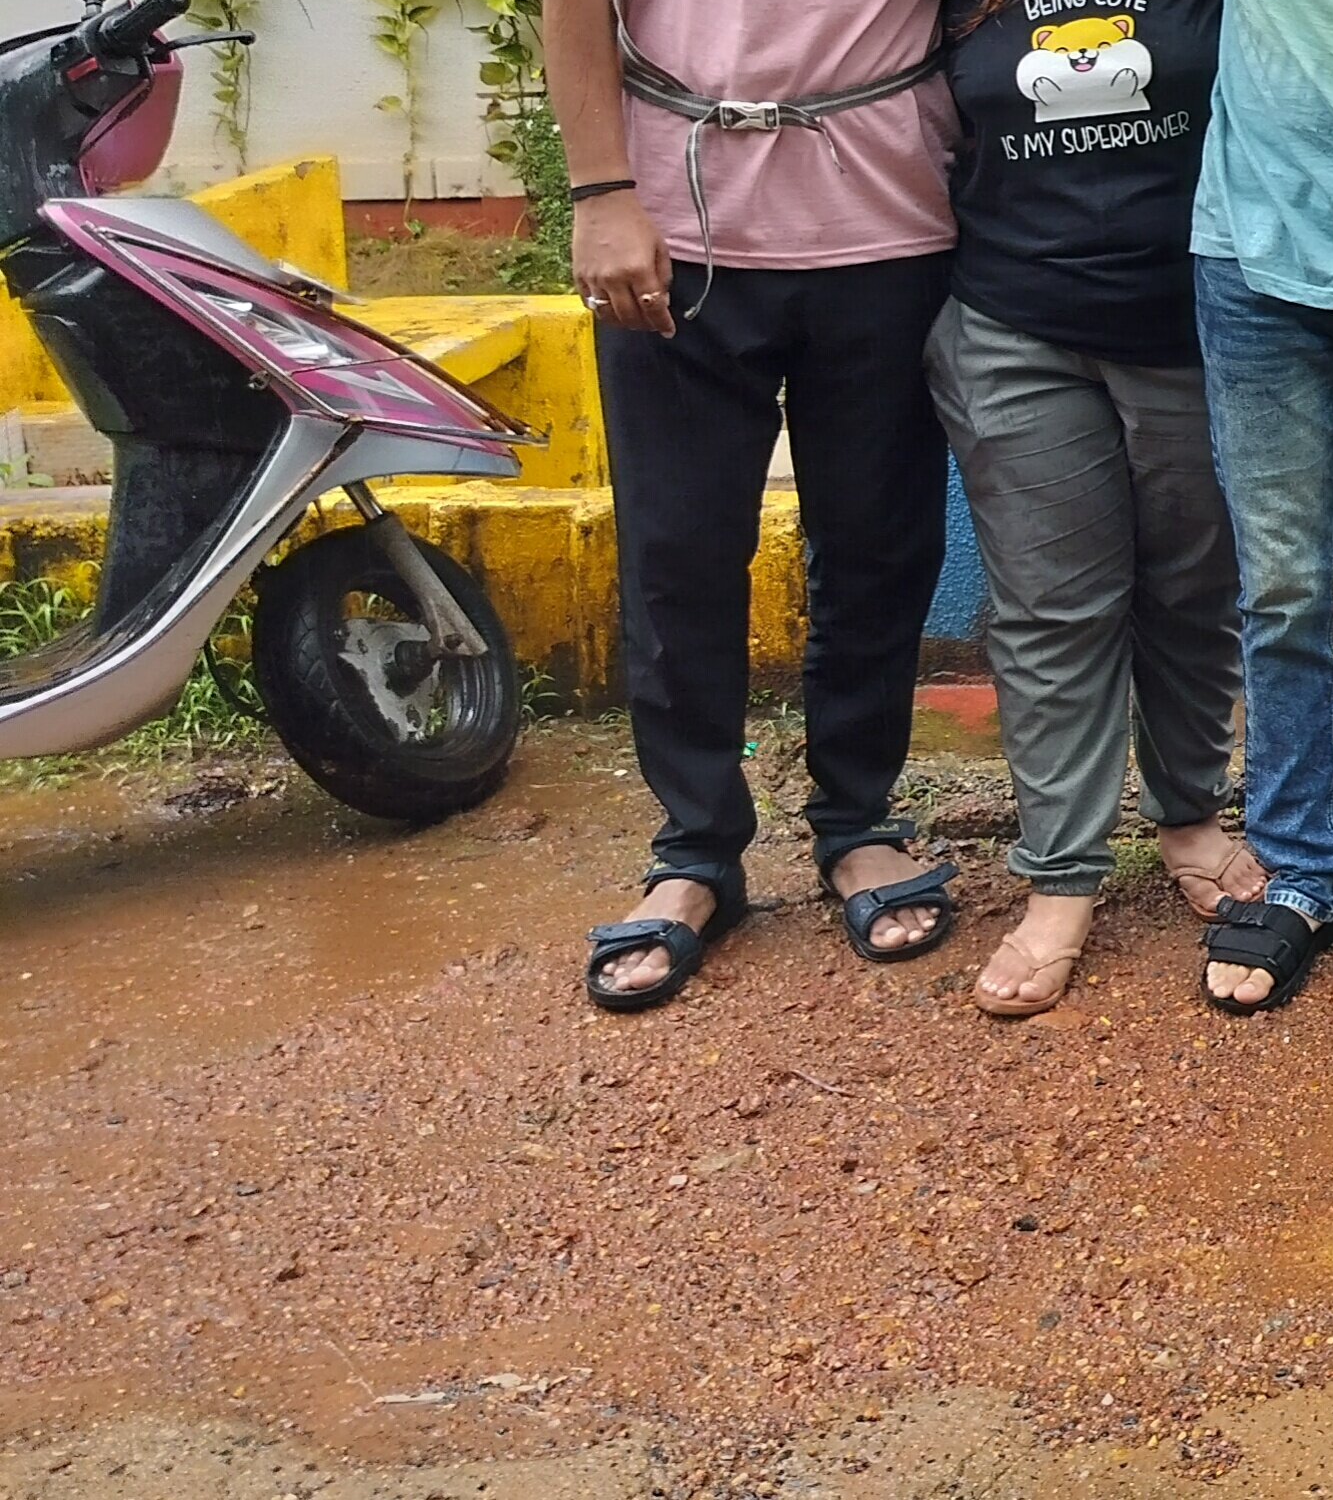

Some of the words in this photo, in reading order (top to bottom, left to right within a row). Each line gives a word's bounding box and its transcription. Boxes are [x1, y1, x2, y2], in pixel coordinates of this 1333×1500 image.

[1000, 136, 1019, 161] IS
[1024, 128, 1055, 159] MY
[1061, 110, 1191, 155] SUPERPOWER
